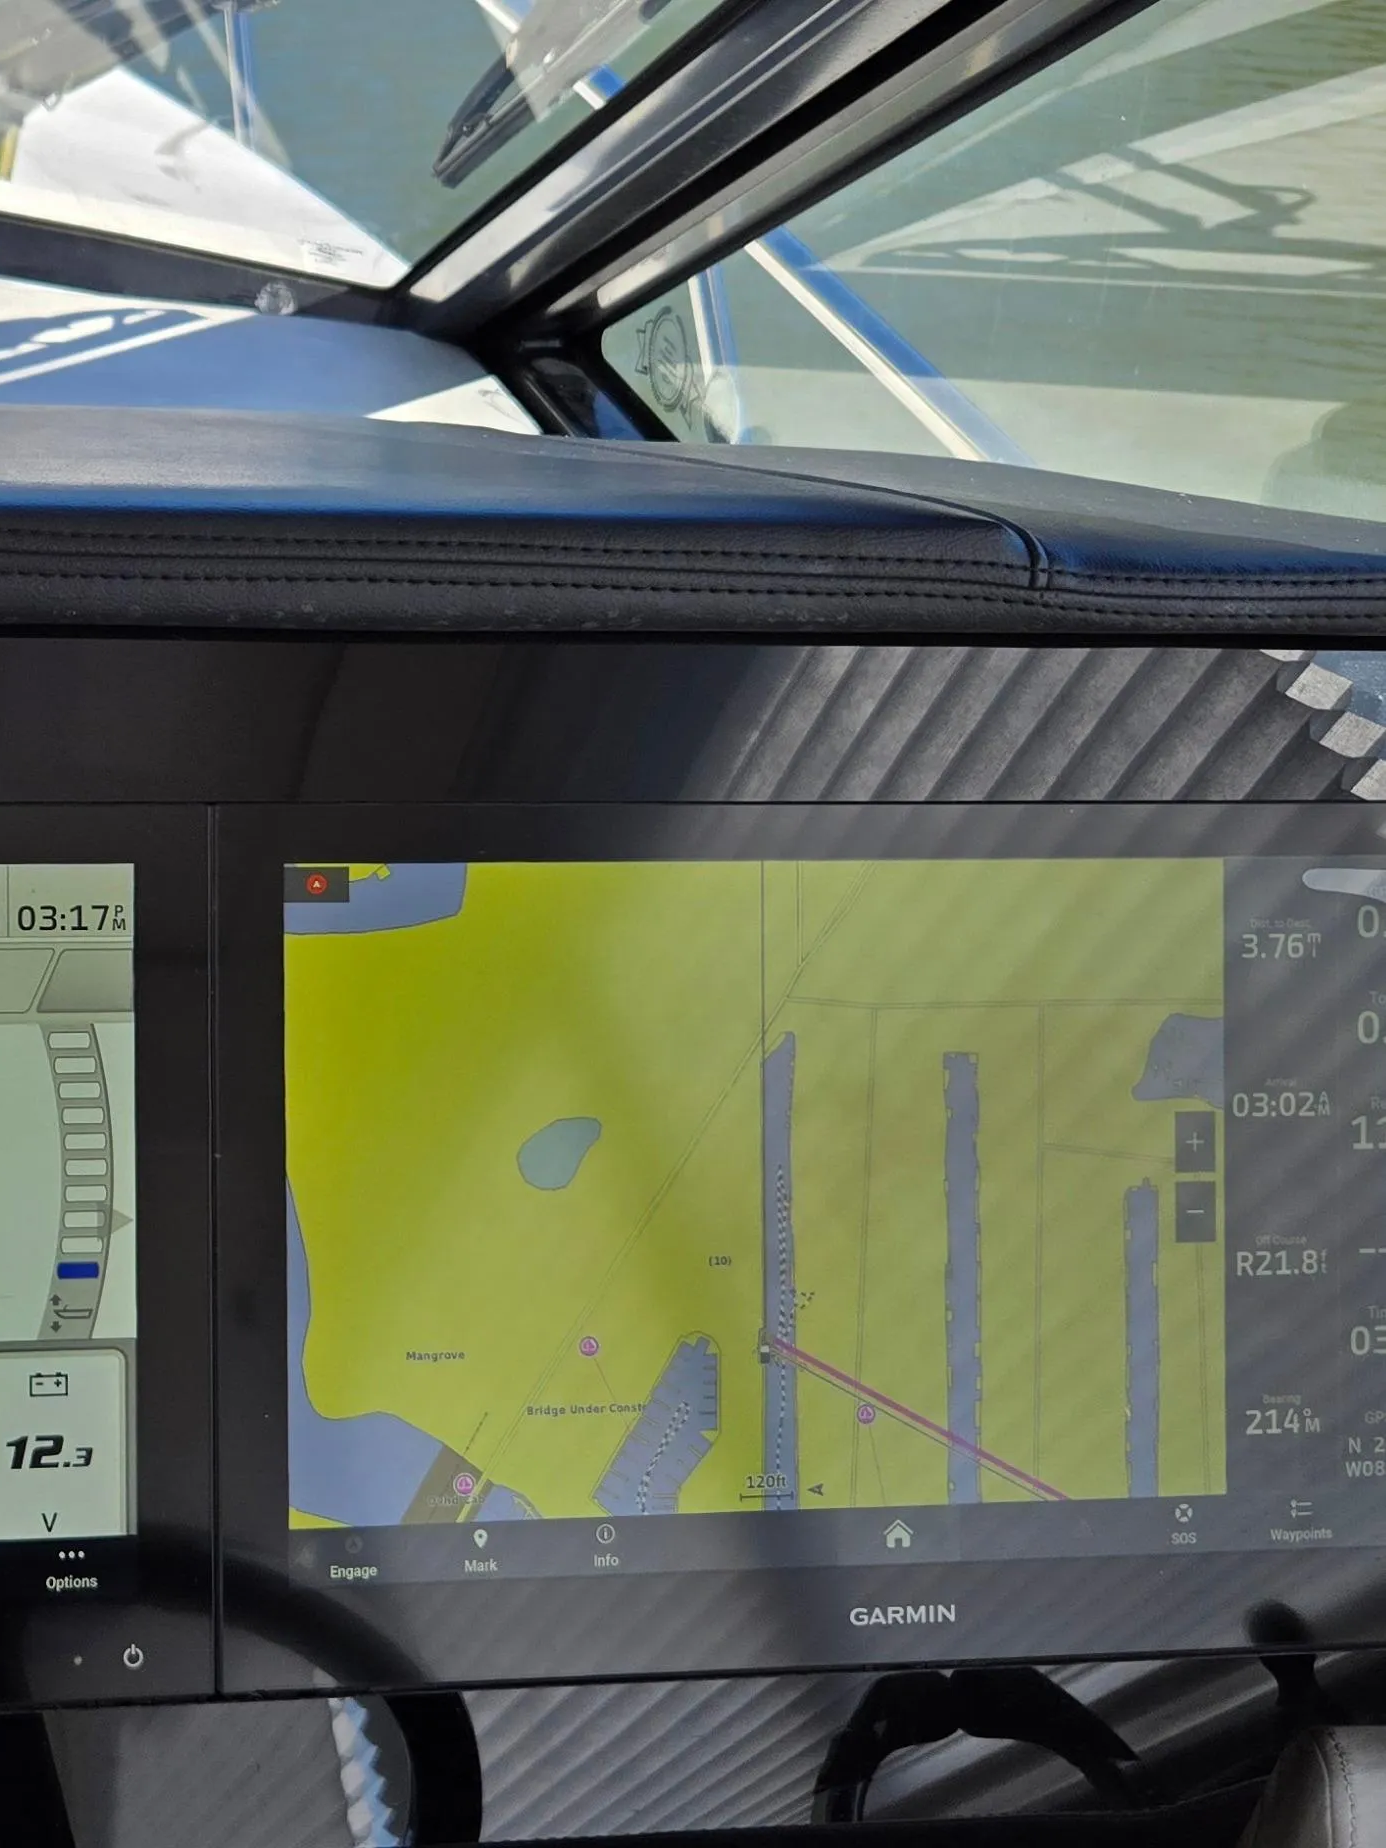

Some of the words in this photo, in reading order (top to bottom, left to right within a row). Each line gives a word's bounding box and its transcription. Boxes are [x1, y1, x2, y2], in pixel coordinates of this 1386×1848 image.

[16, 904, 111, 932] 03:17
[1241, 933, 1304, 959] 3.76
[1232, 1091, 1315, 1118] 03:02
[1236, 1249, 1319, 1277] R21.8
[405, 1349, 466, 1365] Mangrove
[526, 1405, 567, 1418] Bridge
[570, 1403, 605, 1416] Under
[5, 1435, 93, 1470] 12.3
[746, 1474, 786, 1489] 120ft
[41, 1512, 58, 1533] V
[1170, 1532, 1197, 1545] SOS
[1270, 1526, 1333, 1543] Waypoints
[463, 1557, 498, 1574] Mark
[593, 1553, 620, 1568] Info
[329, 1562, 378, 1580] Engage
[45, 1574, 99, 1592] Options
[849, 1603, 956, 1627] GARMIN
